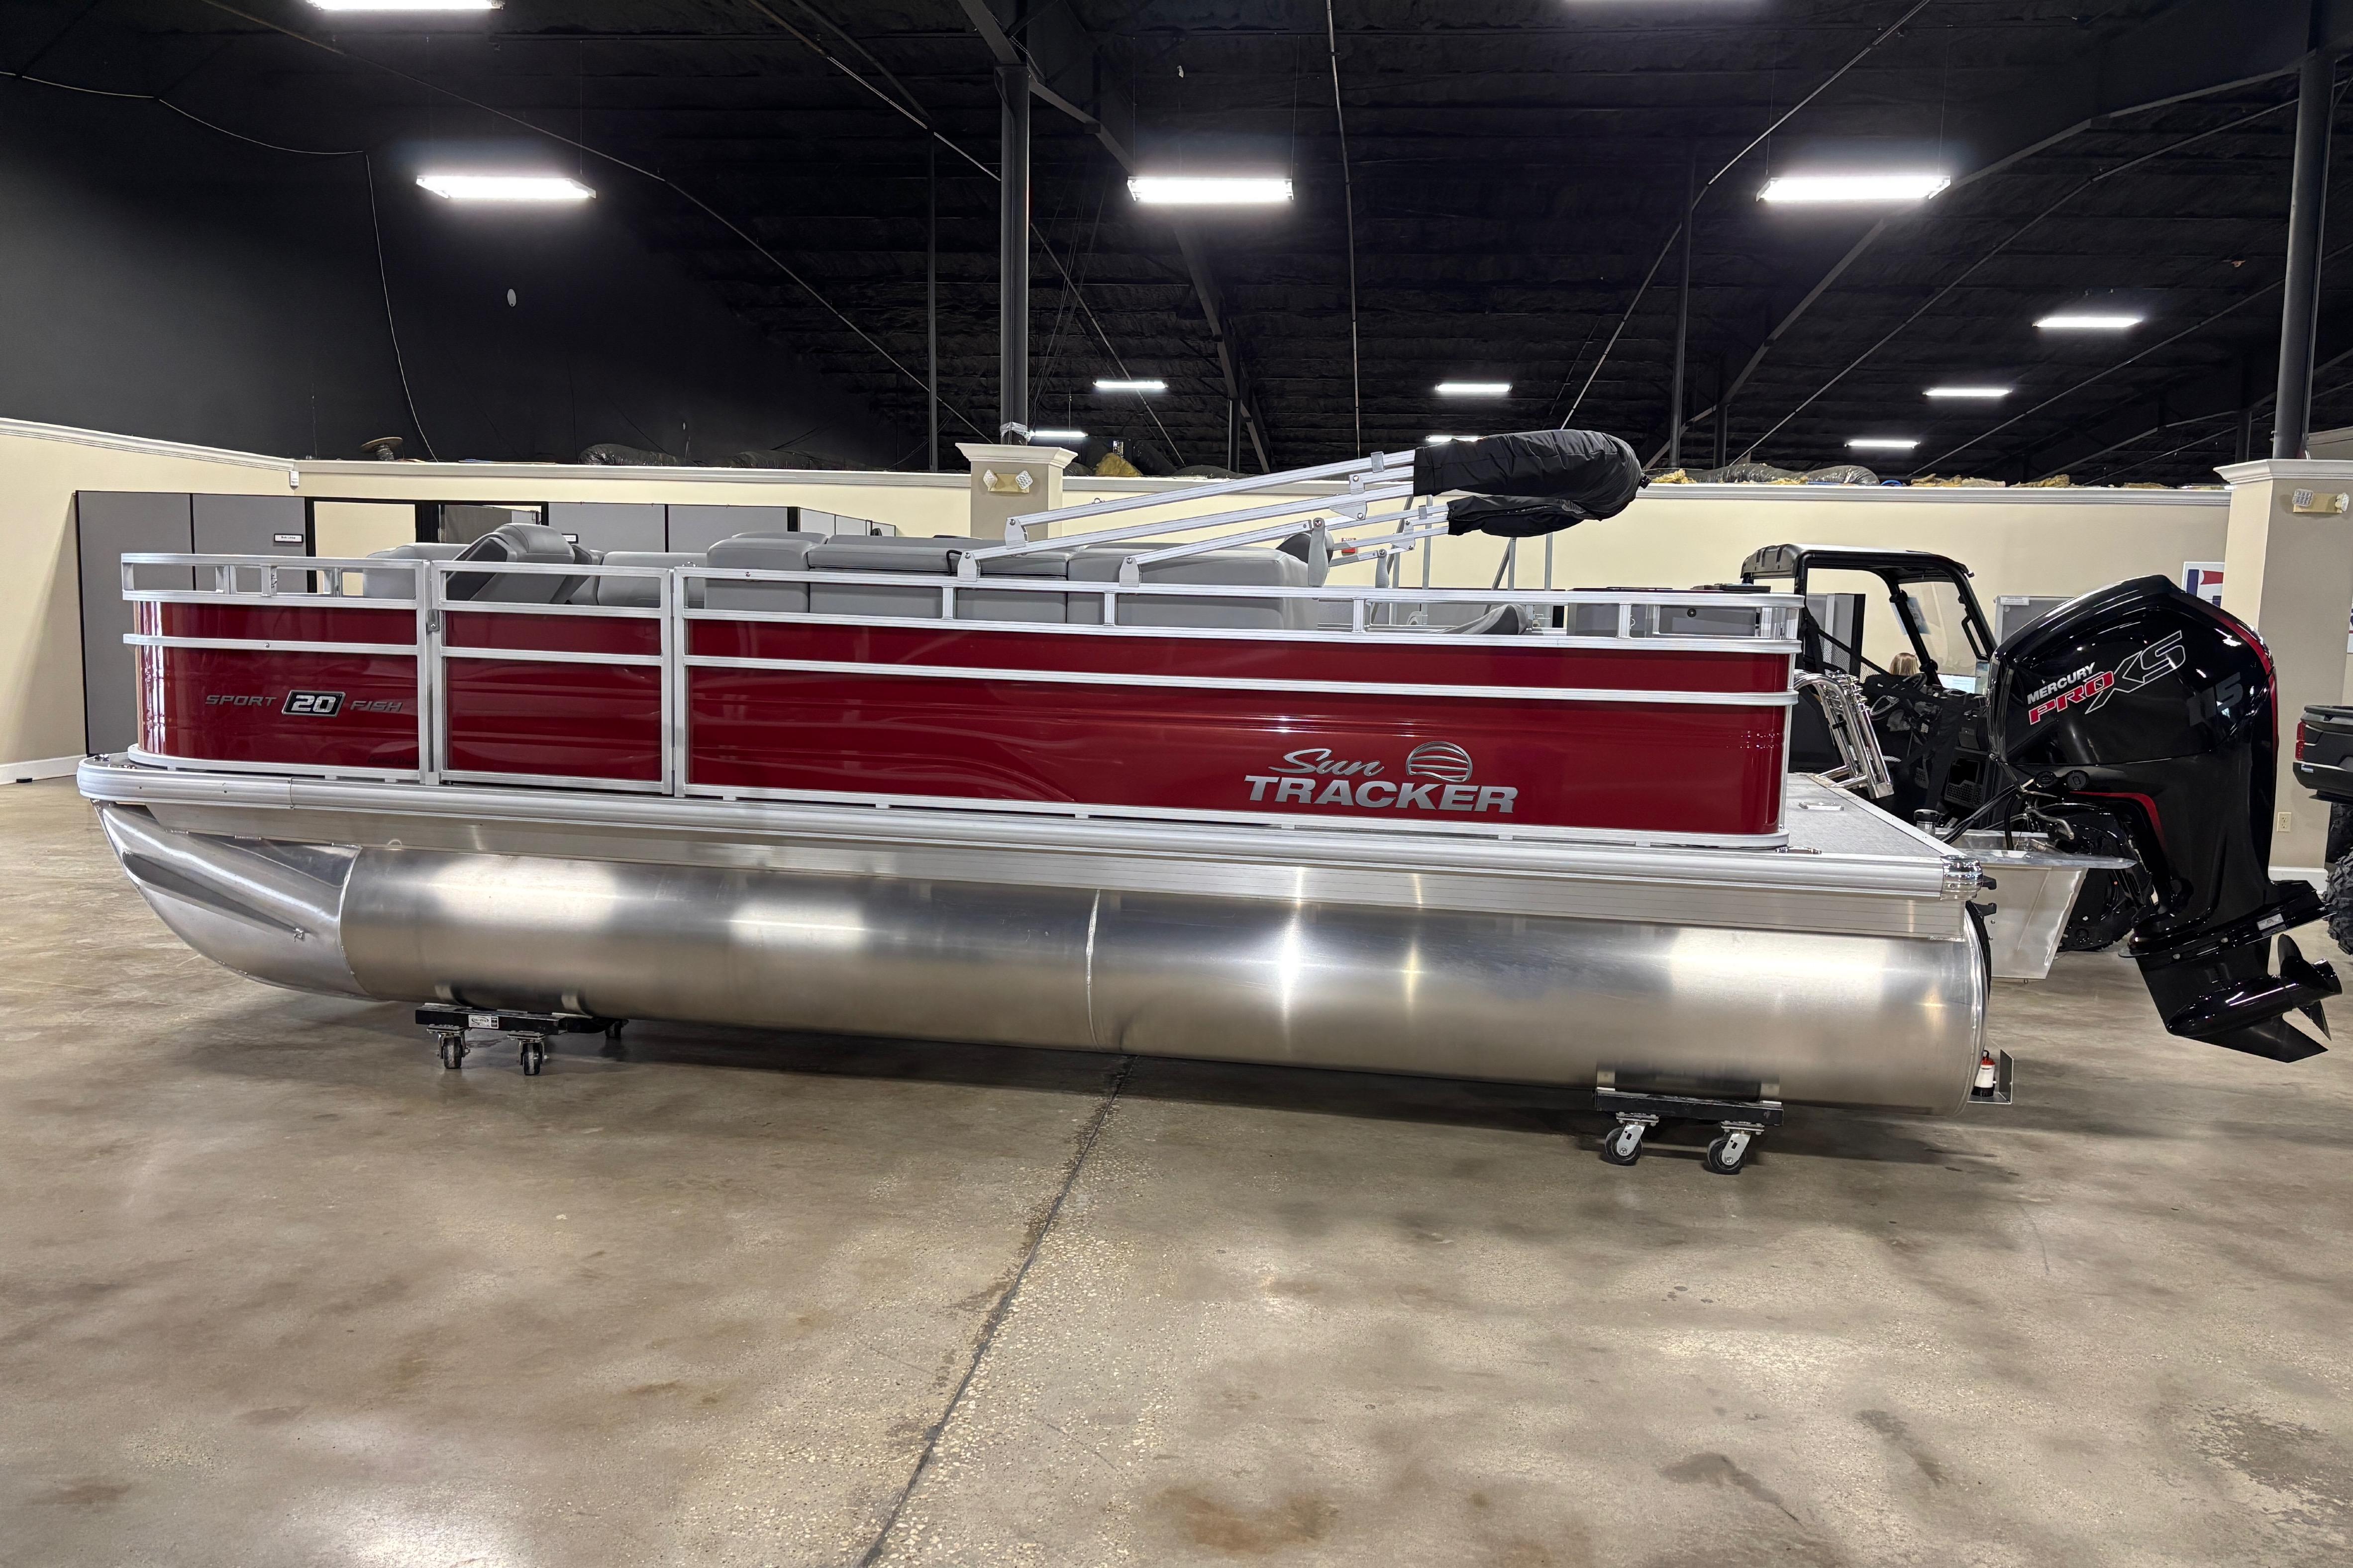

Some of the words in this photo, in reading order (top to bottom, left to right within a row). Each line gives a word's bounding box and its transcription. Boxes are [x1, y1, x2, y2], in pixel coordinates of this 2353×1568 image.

[2027, 662, 2096, 704] MERCURY
[2186, 672, 2244, 727] 115
[205, 695, 277, 706] SPORT
[291, 695, 337, 712] 20
[350, 700, 403, 712] FISH
[1269, 748, 1384, 777] Sun
[1244, 775, 1519, 814] TRACKER
